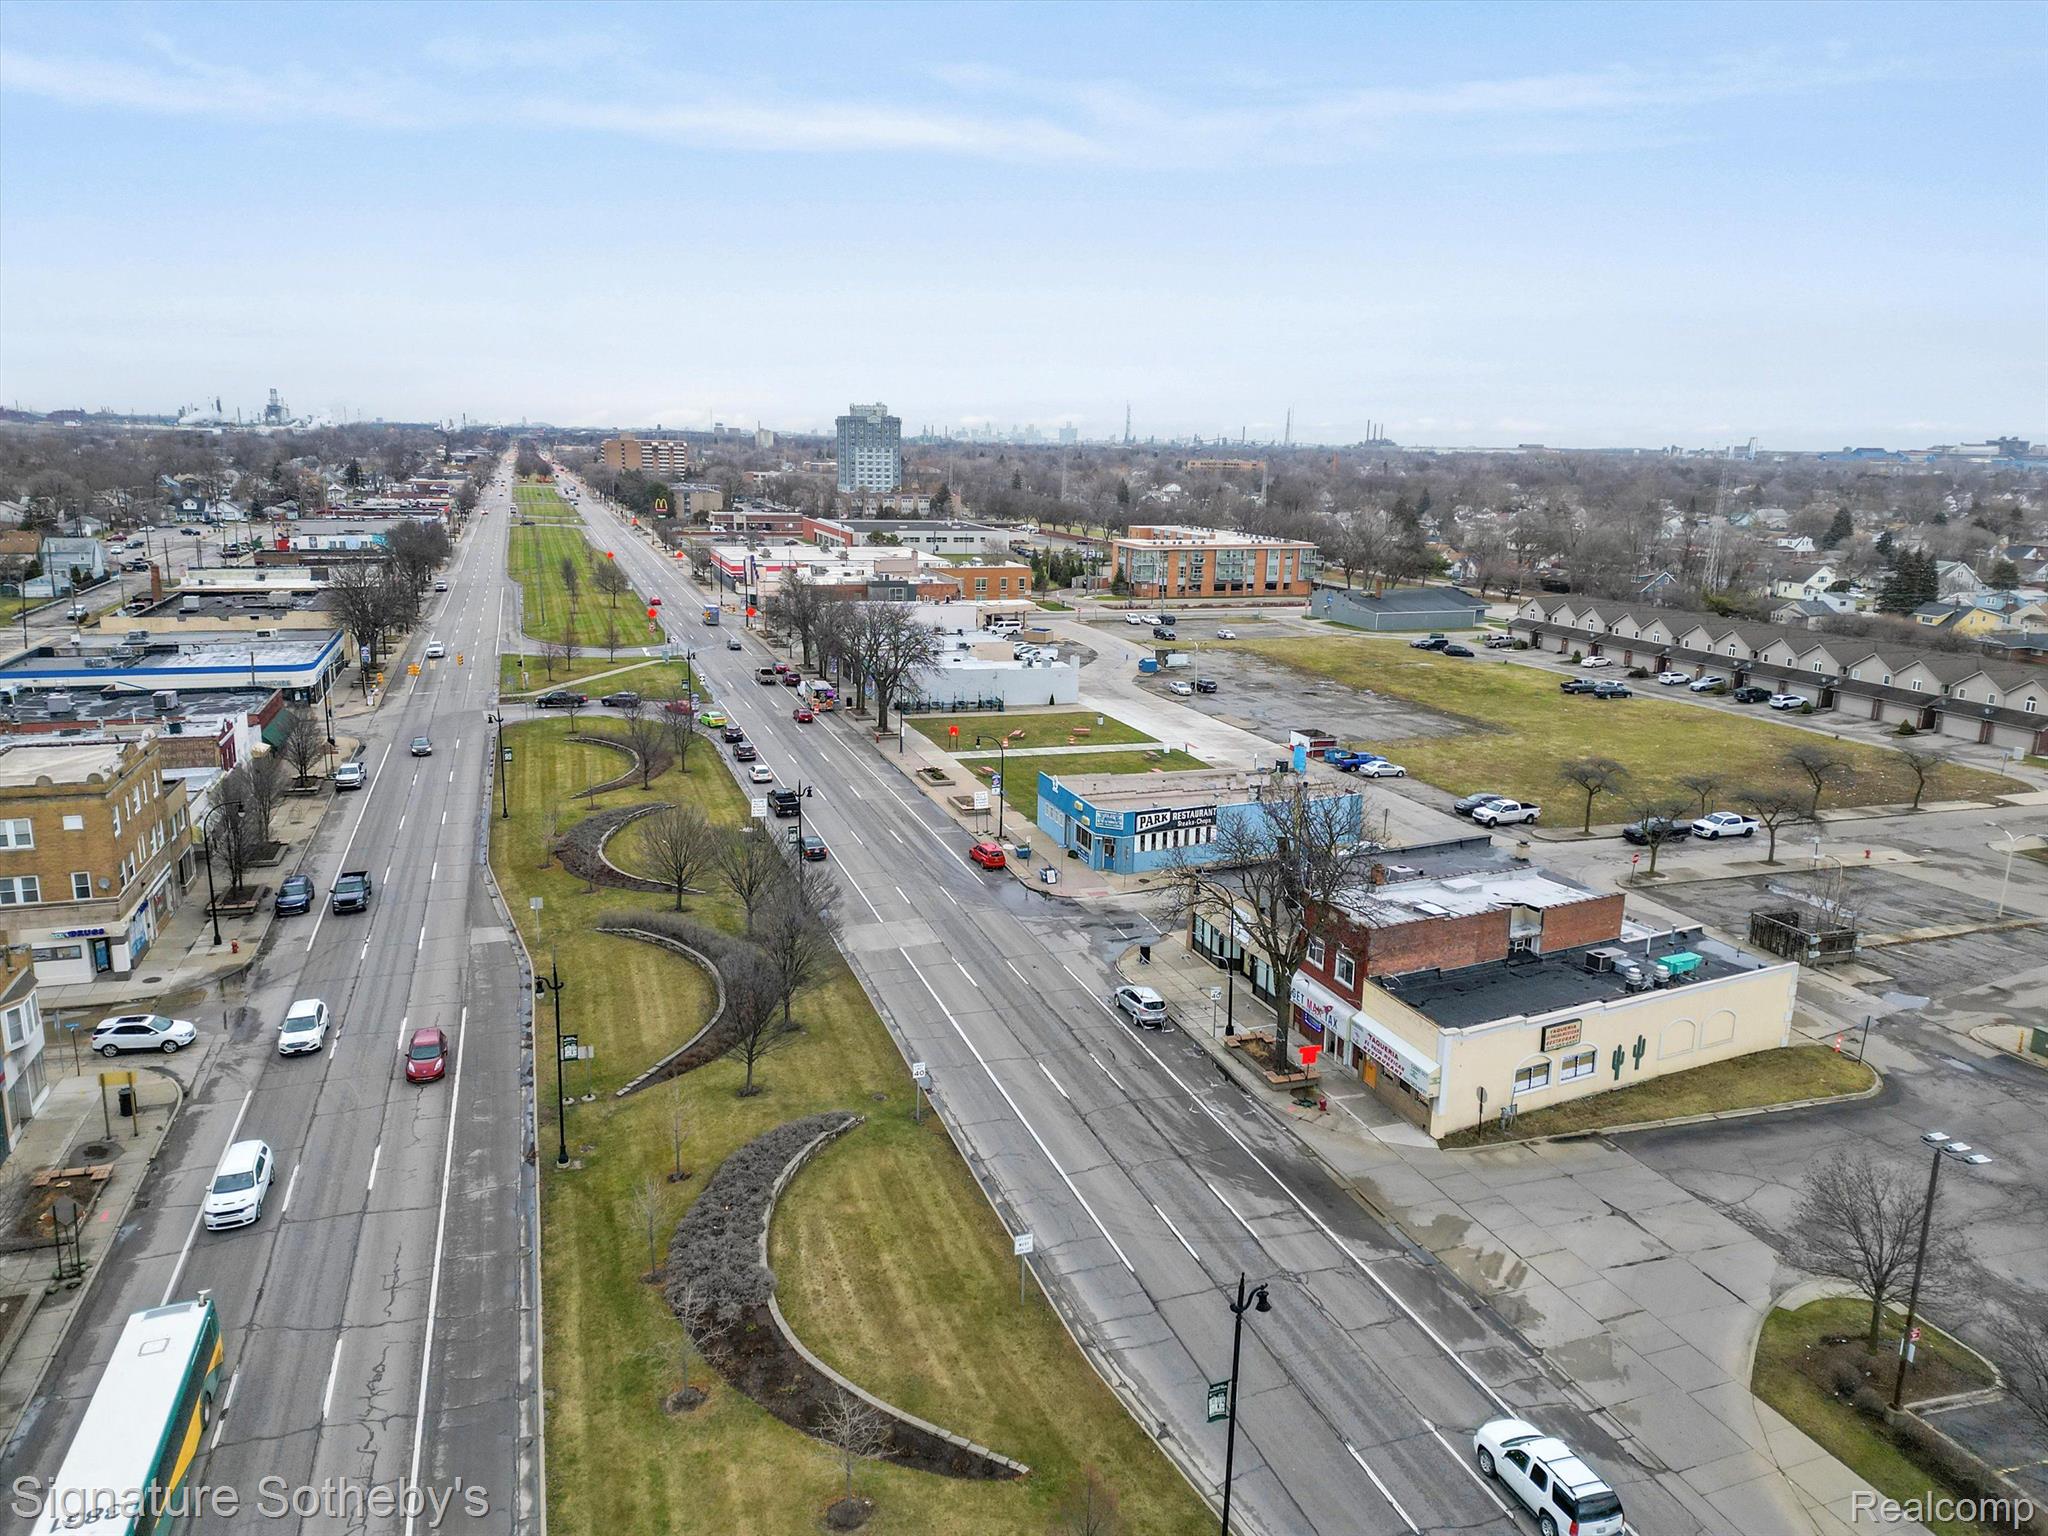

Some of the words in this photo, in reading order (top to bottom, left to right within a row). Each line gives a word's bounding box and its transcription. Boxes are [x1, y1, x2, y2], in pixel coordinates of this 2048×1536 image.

[1139, 813, 1169, 829] PARK
[1172, 807, 1217, 821] RESTAURANT
[1367, 1033, 1400, 1060] TAQUERIA
[914, 1069, 925, 1077] 40
